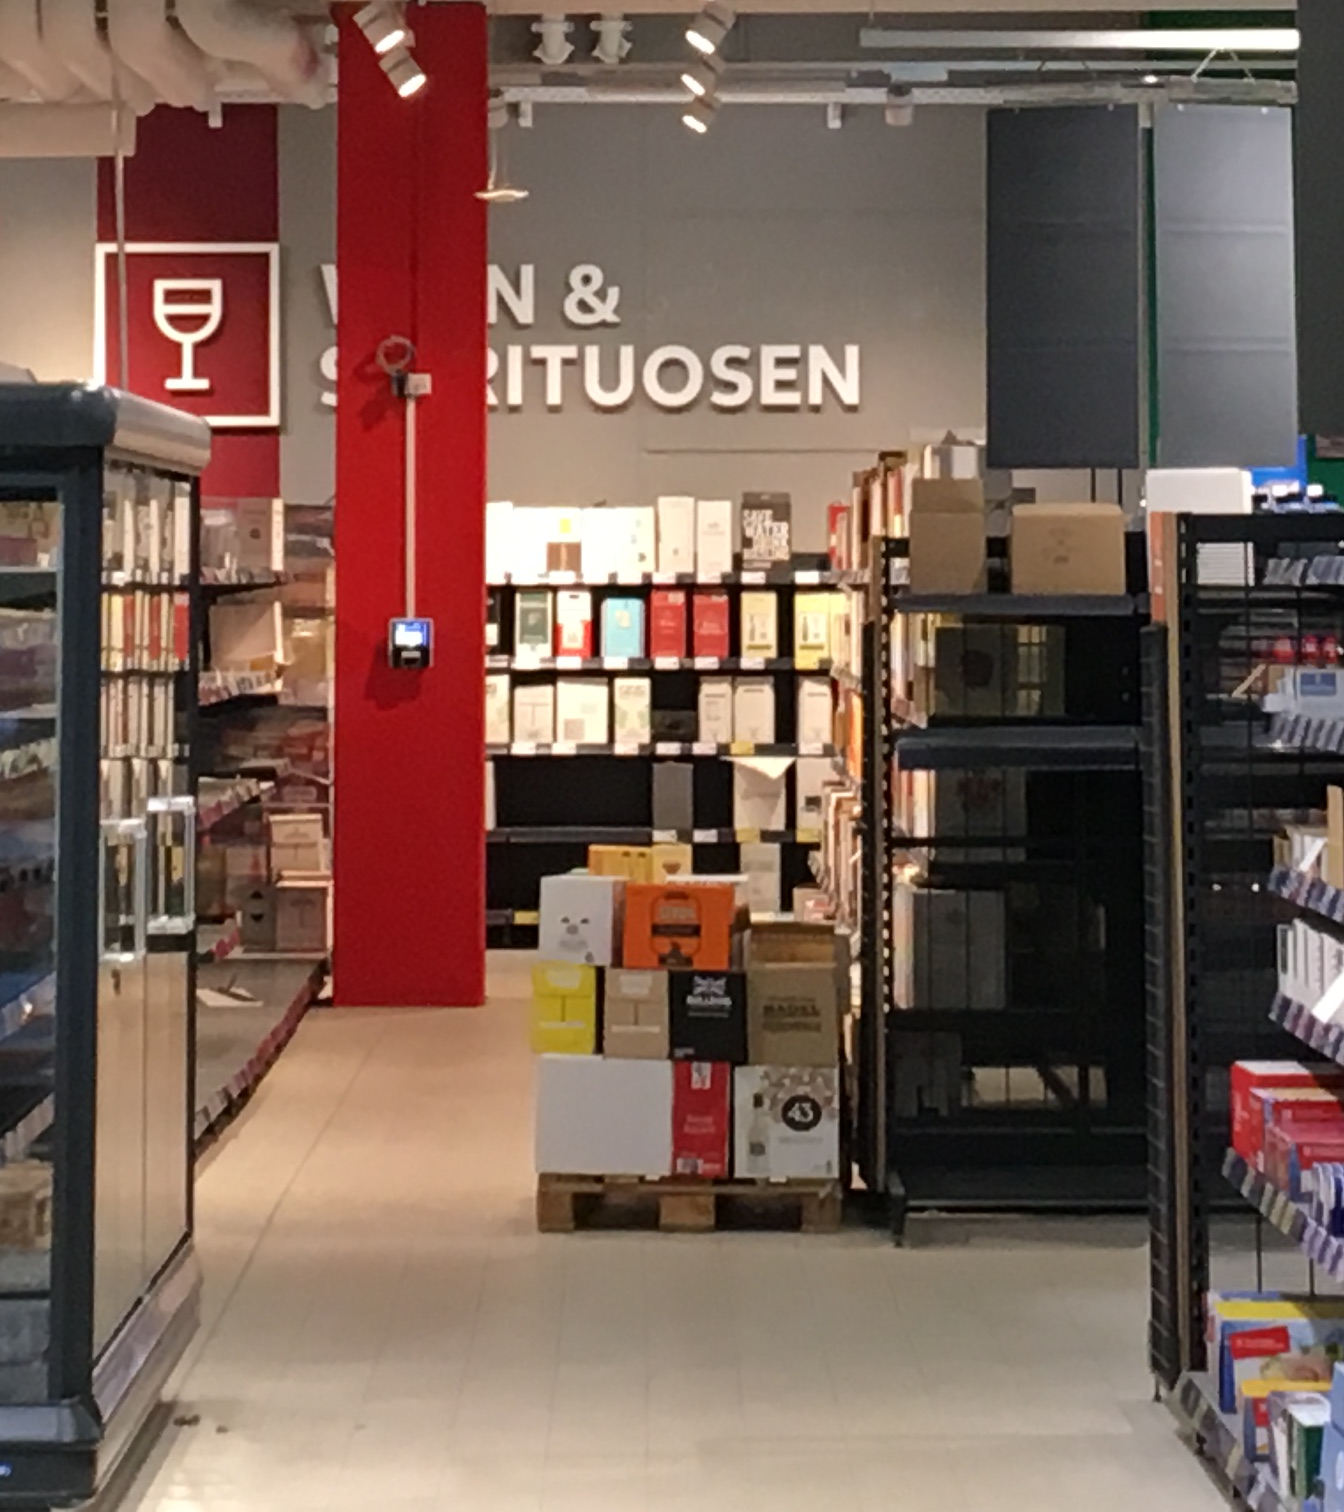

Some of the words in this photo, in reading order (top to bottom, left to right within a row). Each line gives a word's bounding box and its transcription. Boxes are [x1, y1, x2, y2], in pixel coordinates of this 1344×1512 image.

[563, 263, 622, 326] &
[320, 343, 861, 407] ITUOSEN
[787, 1102, 814, 1123] 43
